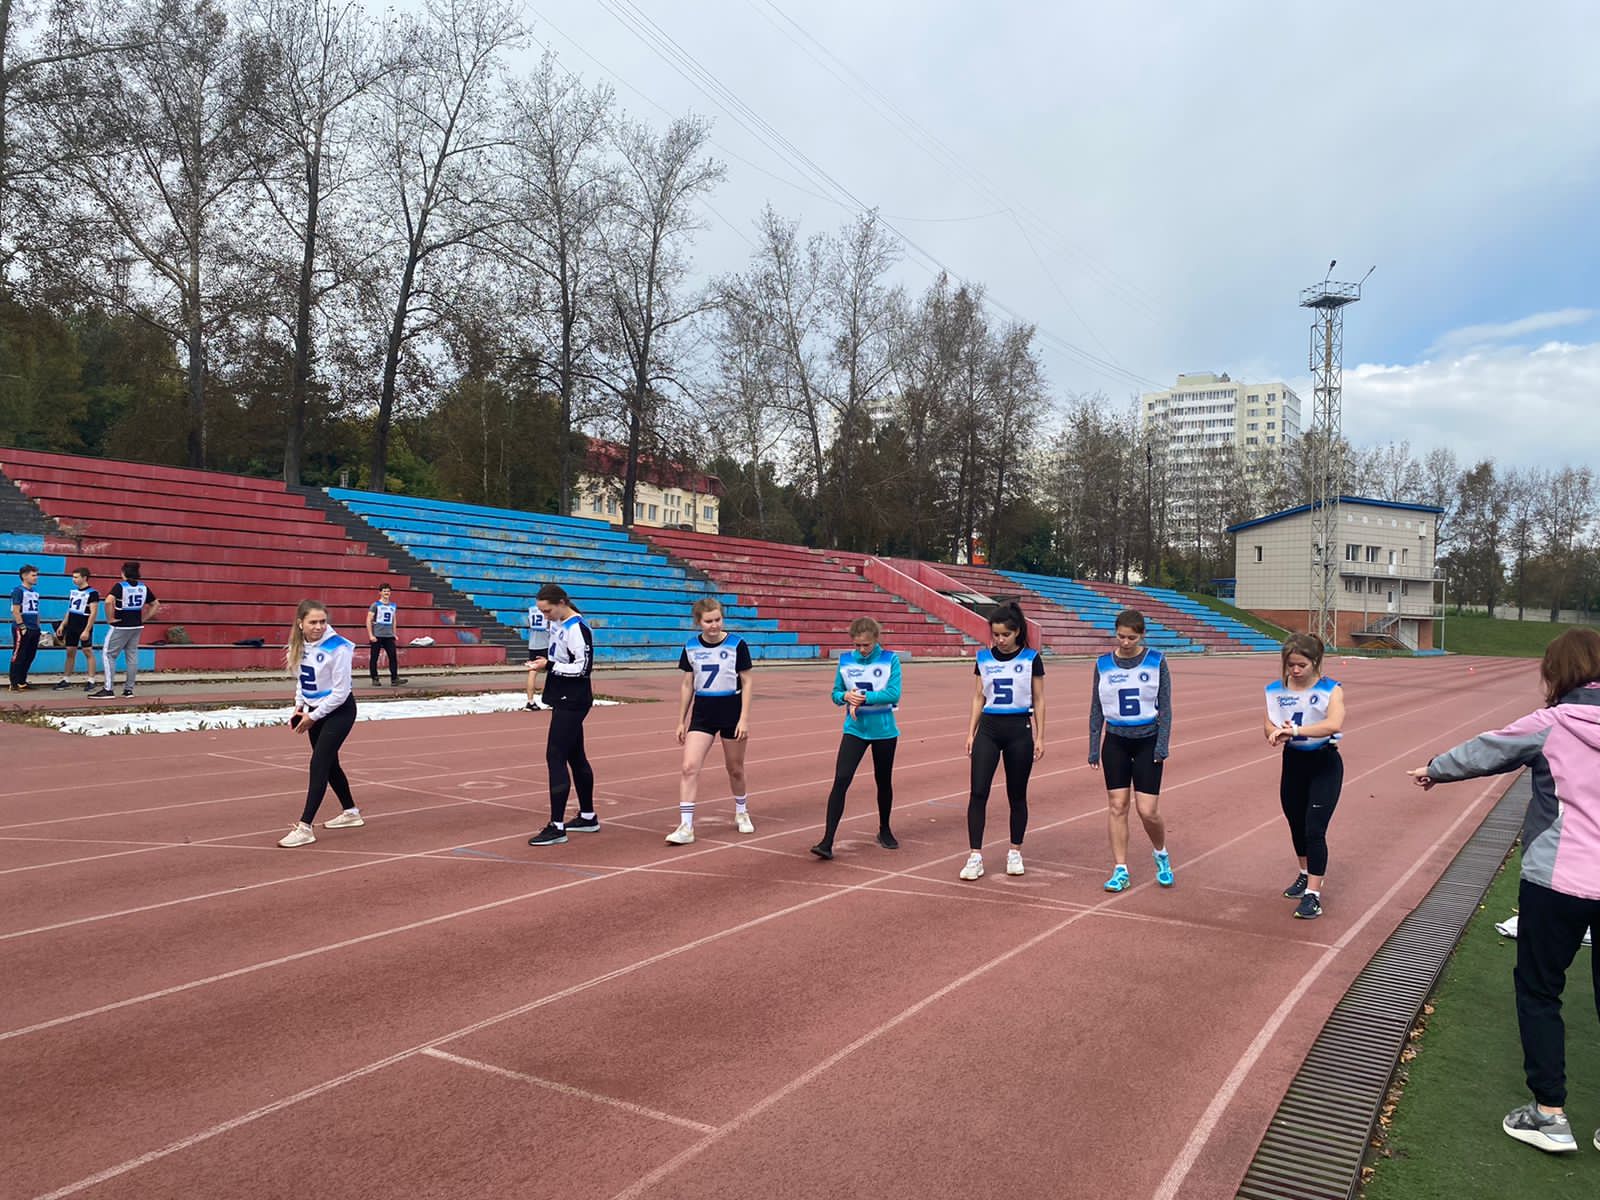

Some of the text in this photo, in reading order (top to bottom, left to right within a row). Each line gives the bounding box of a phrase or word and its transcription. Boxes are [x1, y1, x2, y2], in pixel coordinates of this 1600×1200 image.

[127, 595, 143, 607] 15
[383, 612, 392, 622] 9
[531, 614, 543, 626] 12
[299, 664, 318, 691] 2
[701, 664, 720, 689] 7
[992, 678, 1014, 704] 5
[1118, 688, 1141, 716] 6
